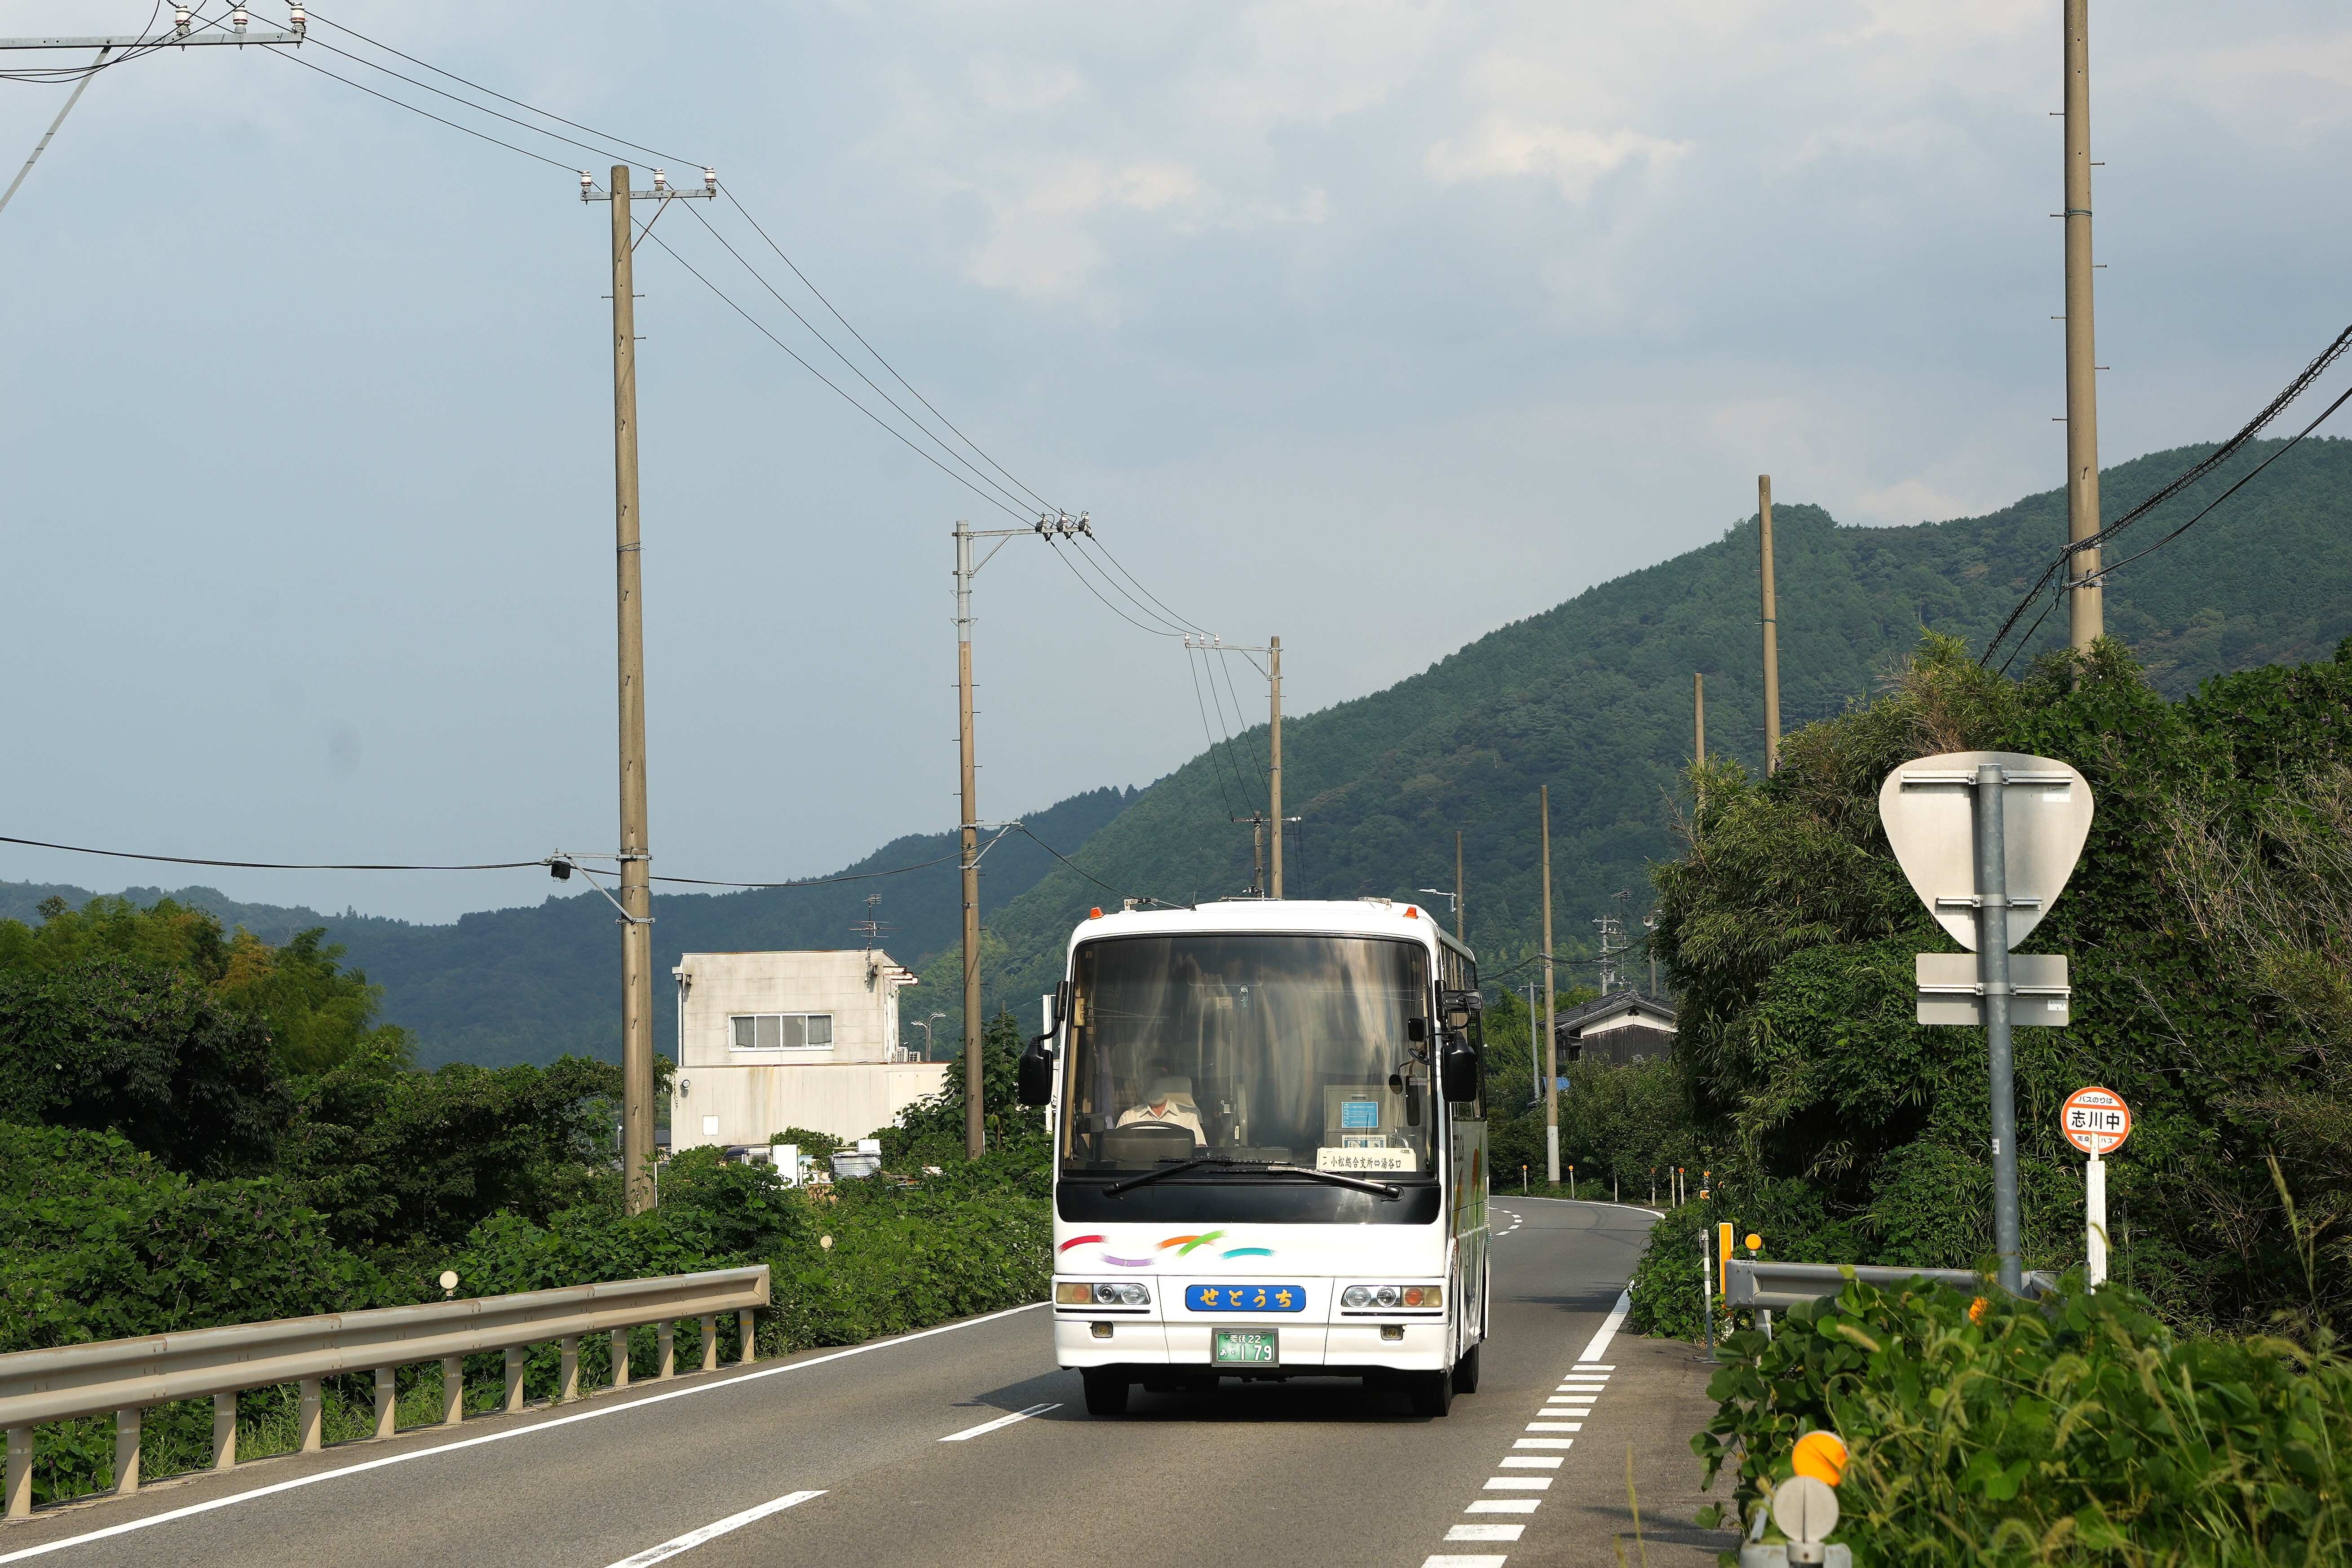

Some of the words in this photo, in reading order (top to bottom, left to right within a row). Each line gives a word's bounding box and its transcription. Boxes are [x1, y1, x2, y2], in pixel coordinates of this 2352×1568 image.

[2079, 1096, 2113, 1104] バスのりば
[2072, 1110, 2119, 1130] 志川中
[1200, 1288, 1292, 1307] せとうち
